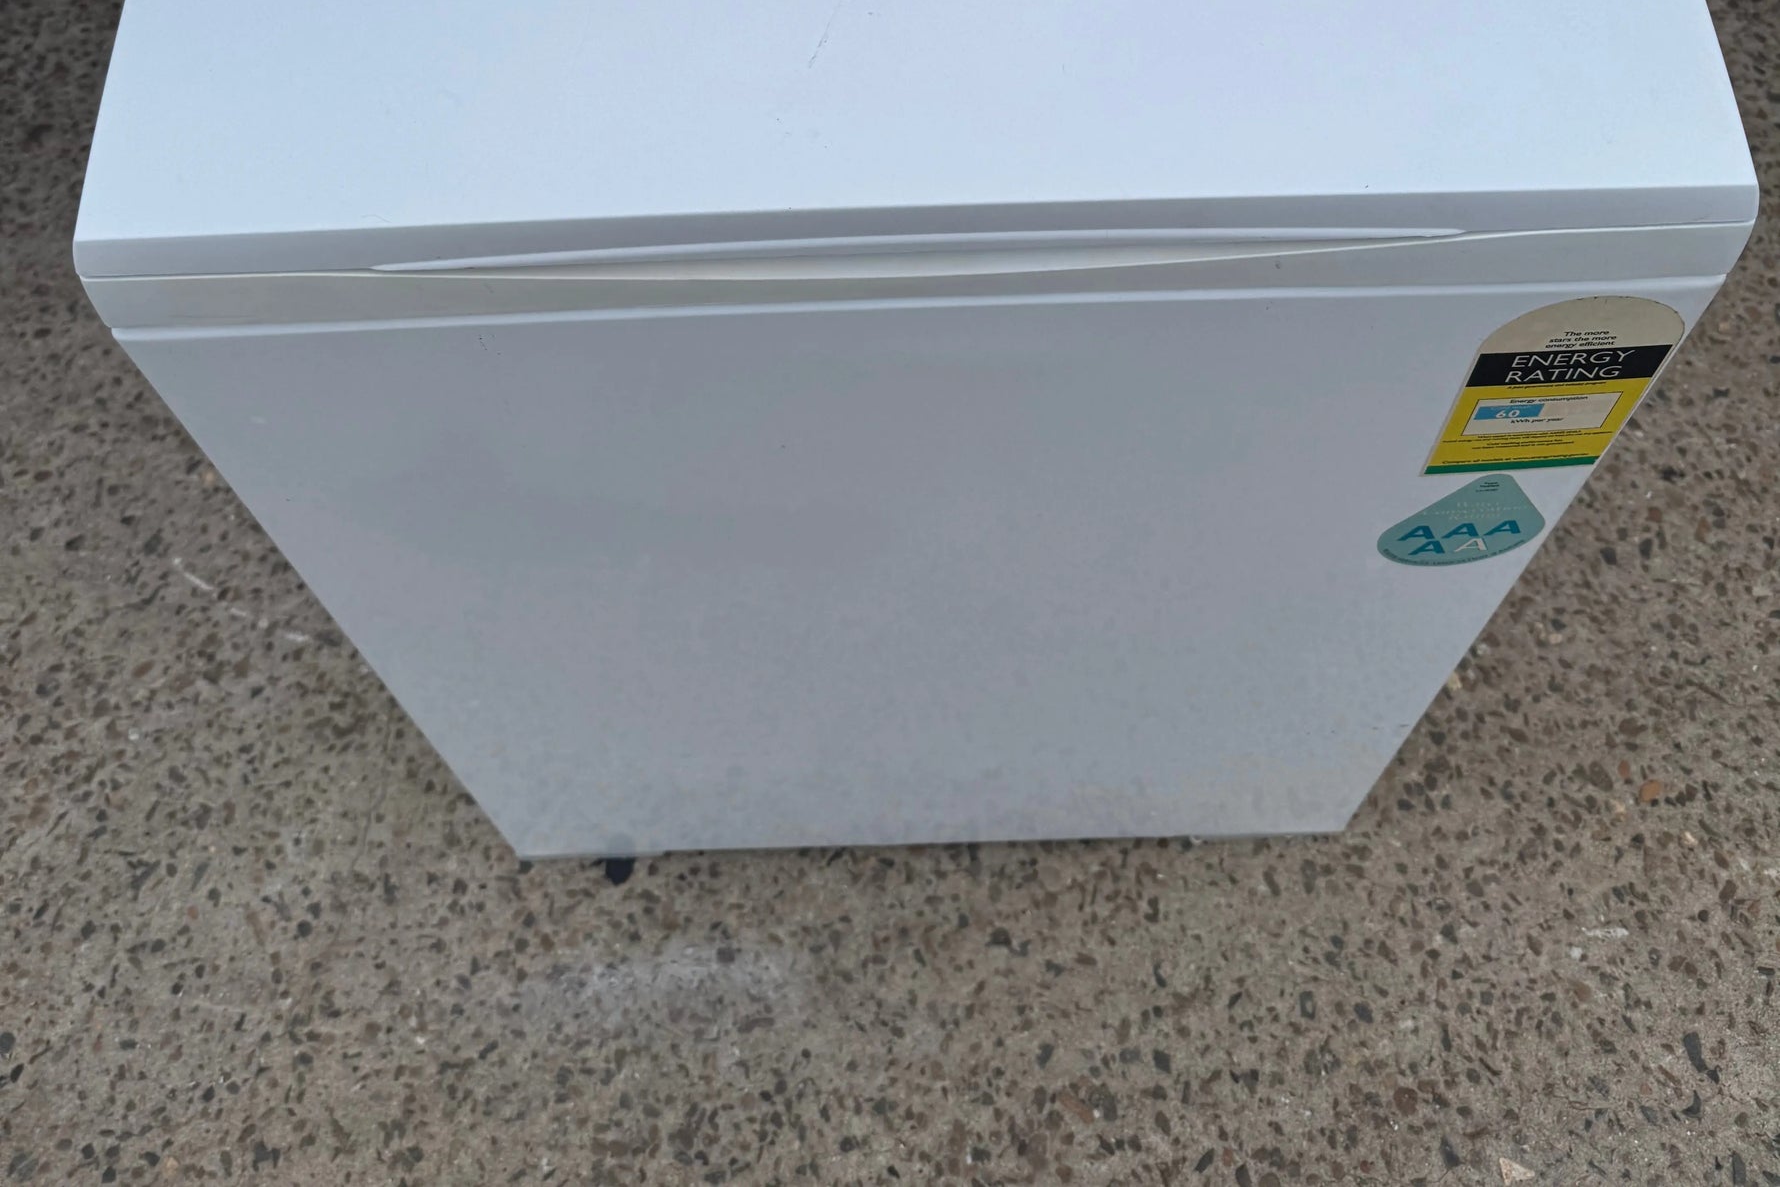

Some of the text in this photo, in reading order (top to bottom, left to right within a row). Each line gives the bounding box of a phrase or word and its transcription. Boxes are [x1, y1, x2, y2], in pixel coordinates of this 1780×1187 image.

[1511, 349, 1635, 368] ENERGY
[1504, 365, 1622, 384] RATING
[1495, 409, 1520, 419] 60
